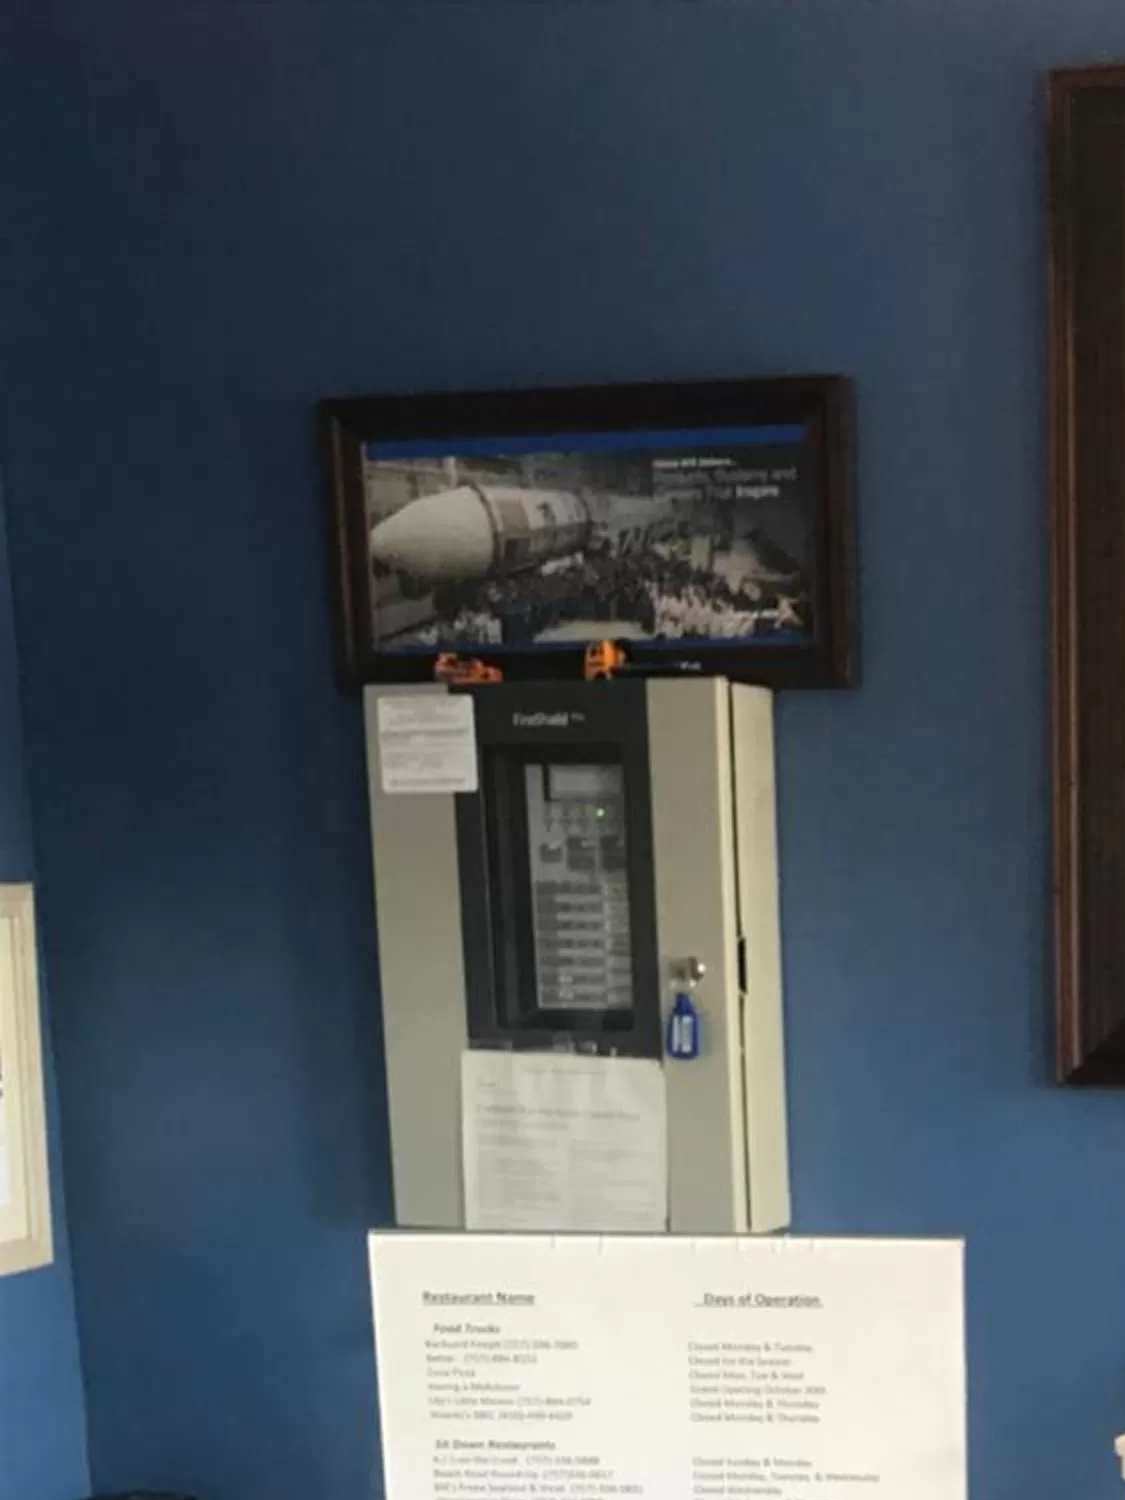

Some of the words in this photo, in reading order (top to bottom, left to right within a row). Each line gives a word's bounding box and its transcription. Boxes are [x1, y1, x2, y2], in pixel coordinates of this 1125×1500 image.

[422, 1291, 491, 1306] Restaurant
[496, 1291, 535, 1306] Name
[704, 1292, 735, 1308] Days
[739, 1292, 752, 1306] of
[754, 1292, 820, 1308] Operation
